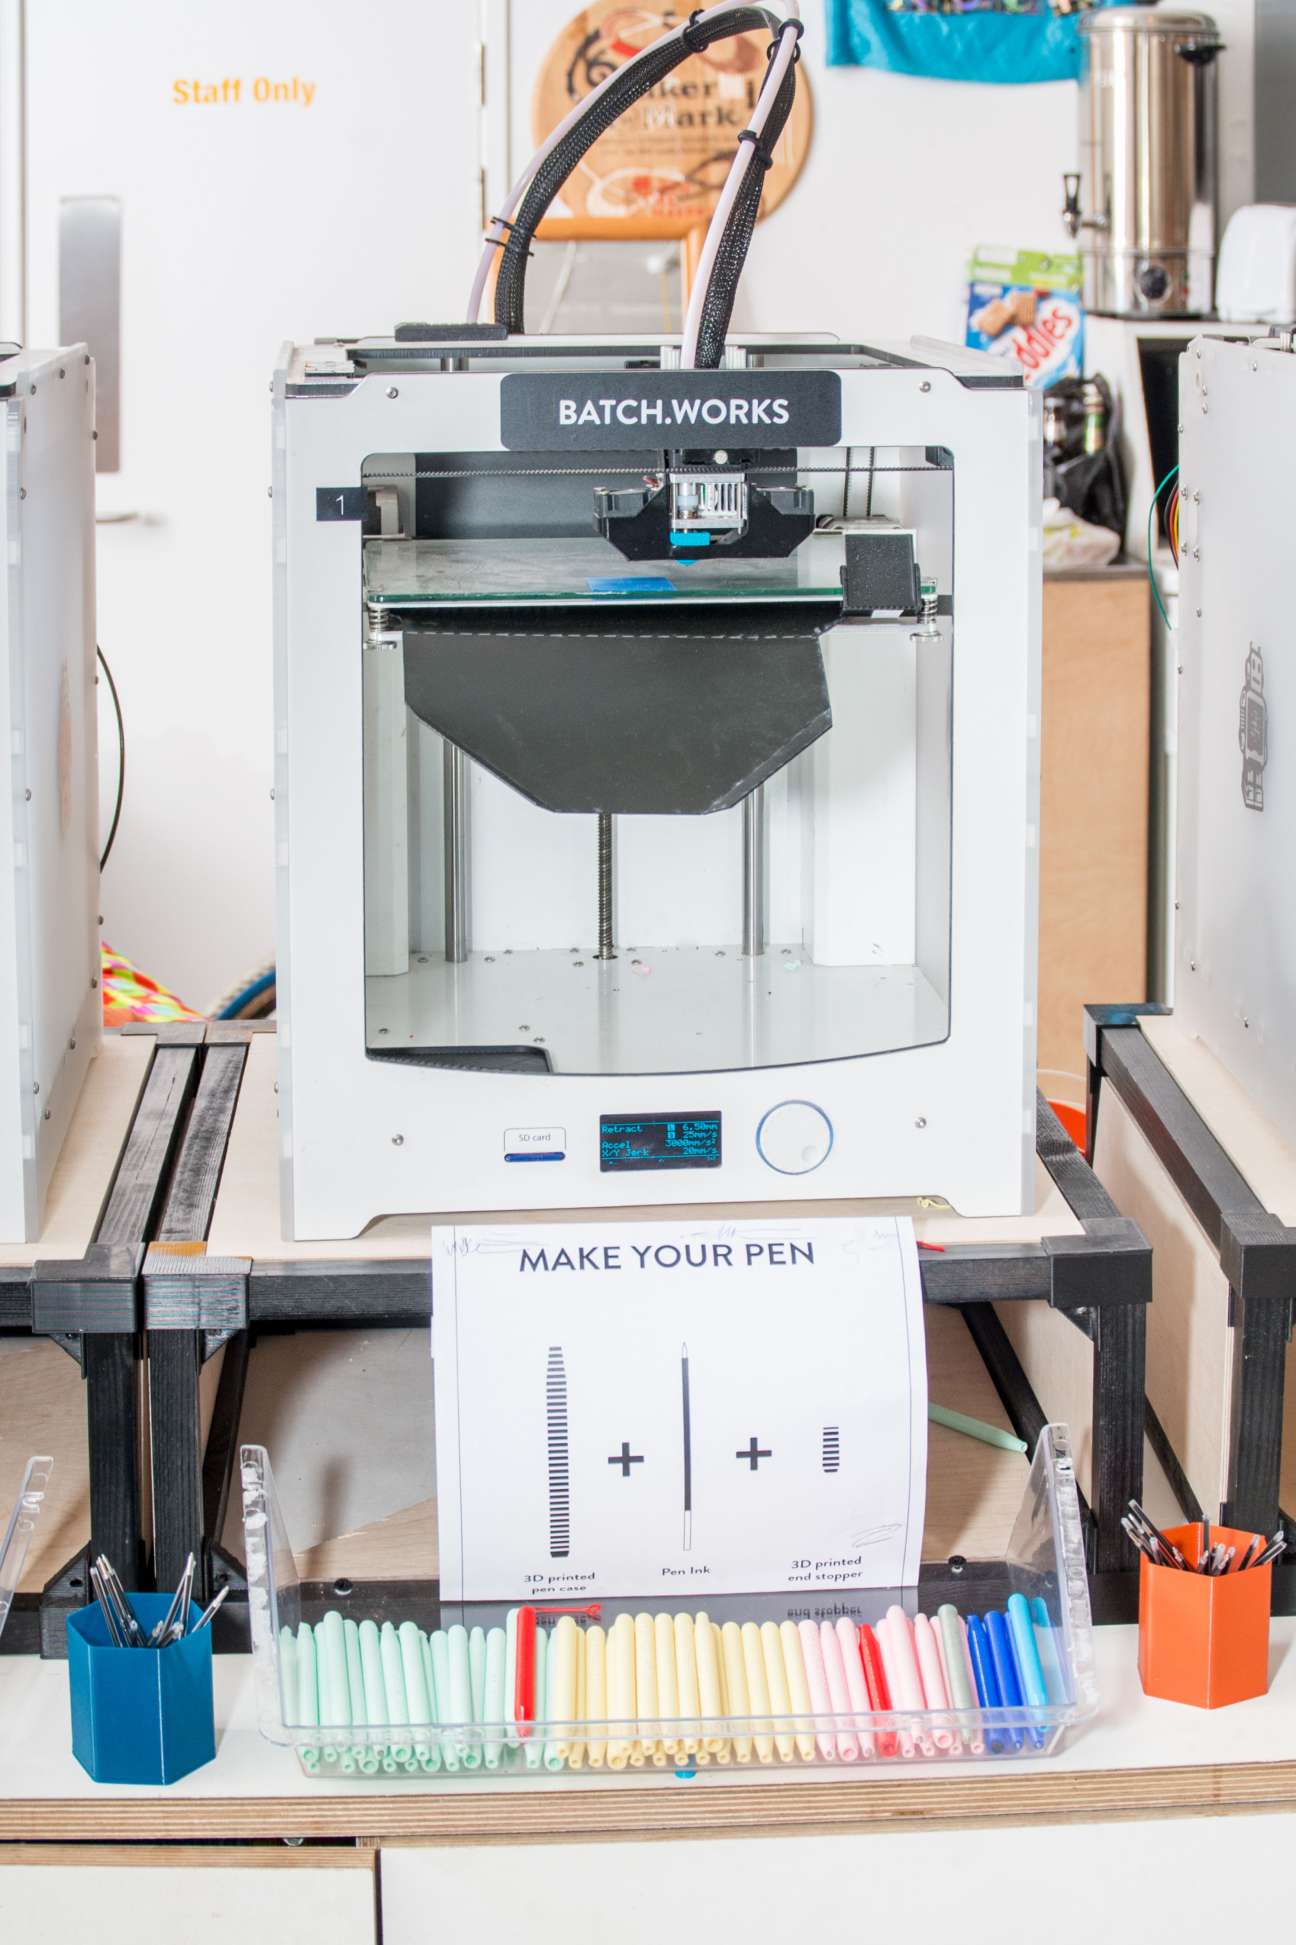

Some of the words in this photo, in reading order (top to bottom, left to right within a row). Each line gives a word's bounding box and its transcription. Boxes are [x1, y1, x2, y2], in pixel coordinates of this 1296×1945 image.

[172, 77, 241, 105] Staff
[252, 75, 316, 107] Only
[558, 398, 790, 426] BATCH.WORKS
[335, 494, 344, 516] 1
[601, 1125, 642, 1134] Retract
[518, 1134, 530, 1142] SD
[531, 1133, 552, 1142] card
[601, 1140, 630, 1149] Accel
[519, 1246, 622, 1273] MAKE
[631, 1243, 734, 1269] YOUR
[745, 1241, 815, 1267] PEN
[790, 1559, 812, 1569] 3D
[815, 1556, 862, 1570] printed
[662, 1567, 686, 1576] Pen
[690, 1565, 711, 1575] Ink
[787, 1572, 812, 1582] end
[815, 1571, 864, 1582] stopper
[523, 1574, 544, 1583] 3D
[548, 1571, 596, 1584] printed
[531, 1586, 556, 1595] pen
